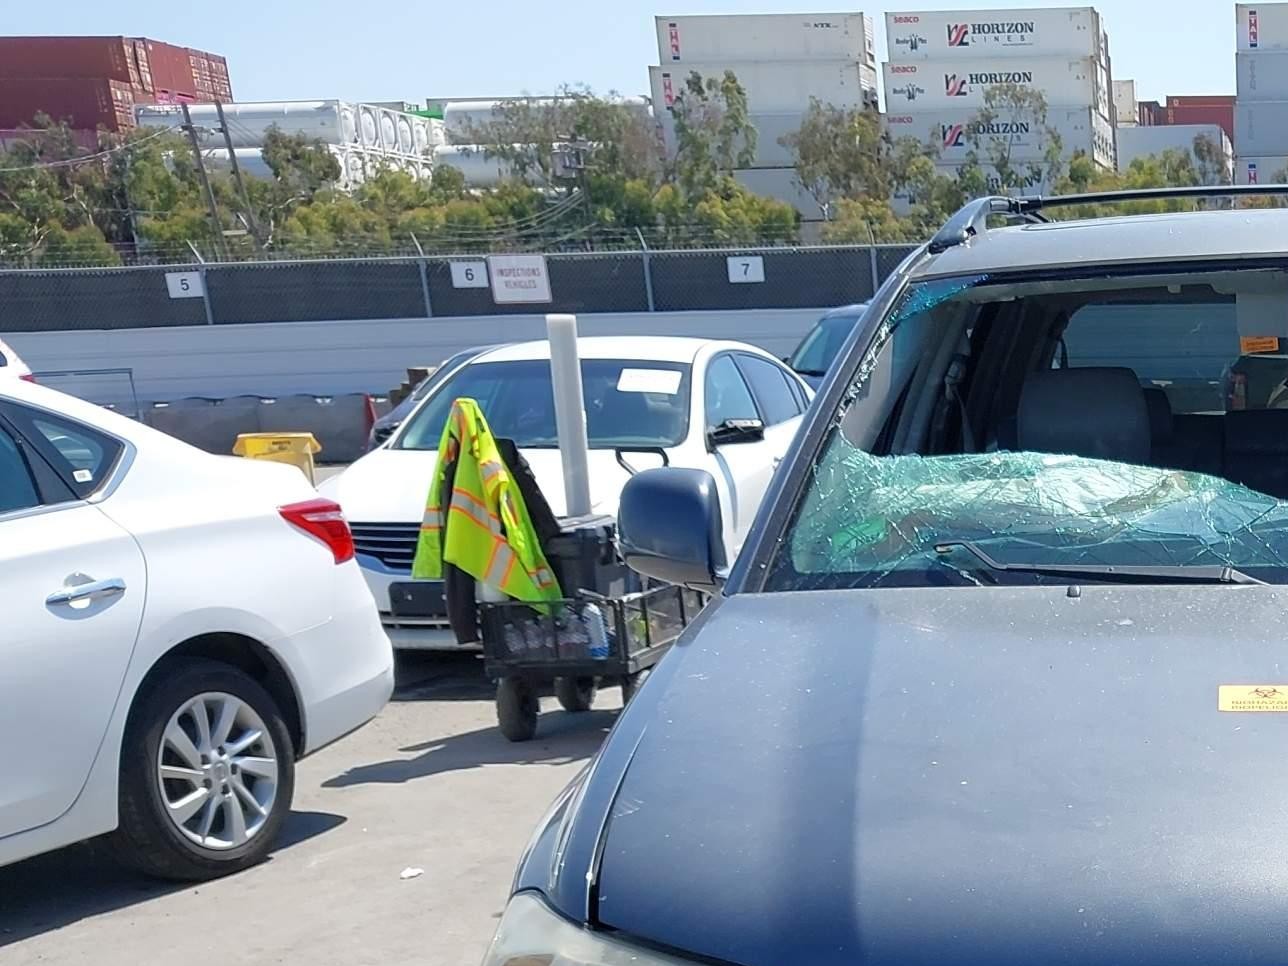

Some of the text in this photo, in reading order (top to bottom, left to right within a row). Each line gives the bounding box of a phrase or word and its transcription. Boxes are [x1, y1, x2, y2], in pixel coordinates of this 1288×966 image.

[893, 16, 920, 24] seaco
[971, 22, 1034, 34] HORIZON
[971, 34, 1026, 43] LINES
[890, 66, 917, 74] seaco
[968, 72, 1033, 84] HORIZON
[465, 268, 475, 282] 6
[741, 263, 750, 276] 7
[180, 278, 190, 292] 5
